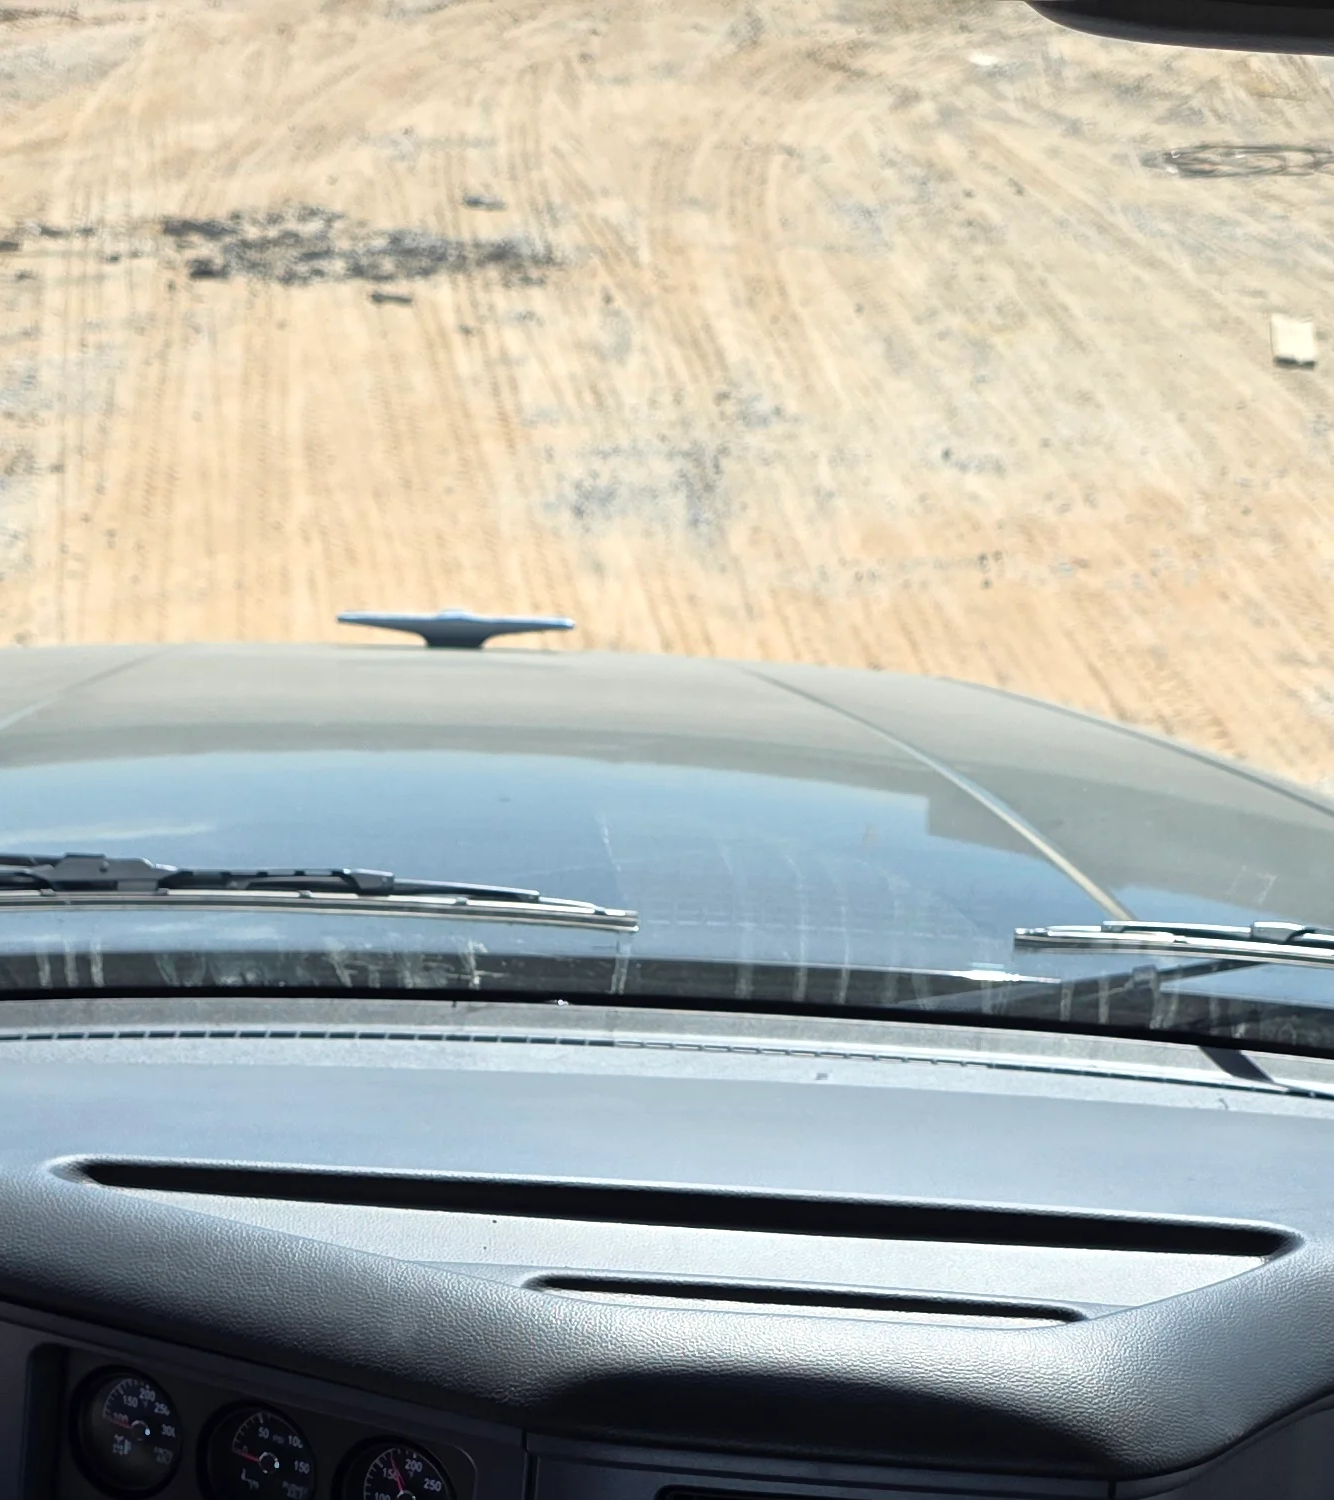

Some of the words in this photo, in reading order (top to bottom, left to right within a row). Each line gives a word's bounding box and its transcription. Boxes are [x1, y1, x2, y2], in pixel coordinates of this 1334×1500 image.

[122, 1394, 138, 1409] 150
[138, 1386, 156, 1402] 200
[258, 1426, 270, 1440] 50
[294, 1460, 311, 1475] 150
[404, 1458, 424, 1473] 200
[423, 1477, 443, 1492] 250
